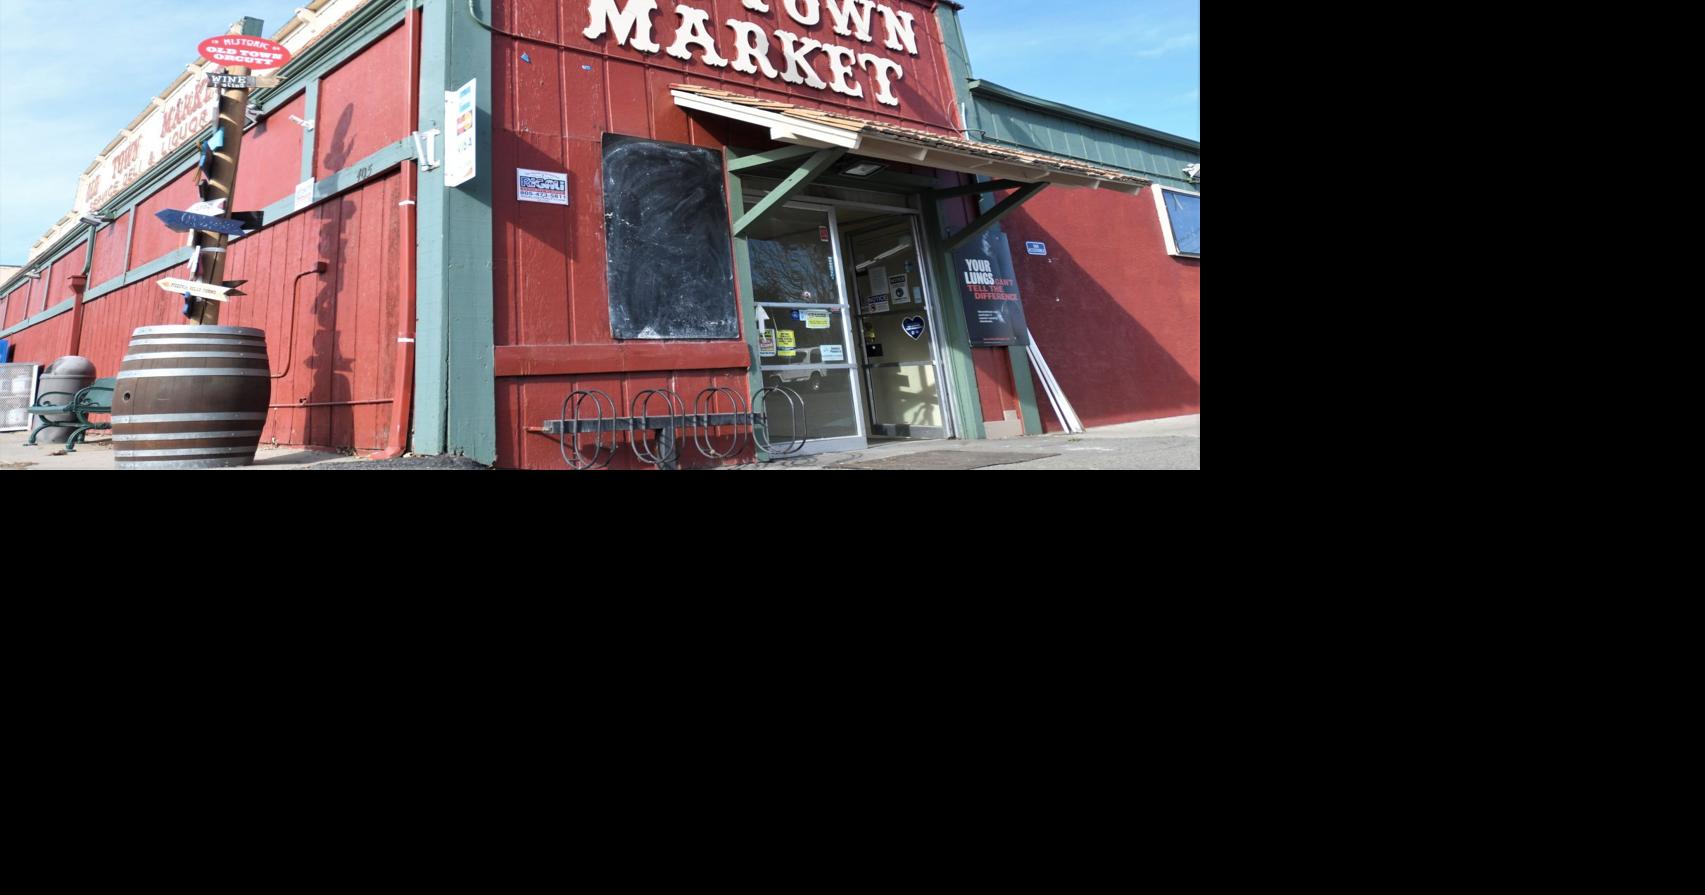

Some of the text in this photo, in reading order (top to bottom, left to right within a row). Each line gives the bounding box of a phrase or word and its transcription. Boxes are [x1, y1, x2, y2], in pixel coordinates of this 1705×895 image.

[741, 0, 918, 55] OWN
[223, 38, 271, 50] HISTORIC
[206, 46, 284, 61] OLD TOWN
[213, 53, 274, 65] ORCUTT
[583, 0, 903, 106] MARKET
[211, 74, 247, 84] WINE
[160, 108, 208, 156] LIQUOR
[964, 258, 992, 273] YOUR
[964, 271, 995, 286] LUNGS
[967, 284, 1005, 294] TELL THE
